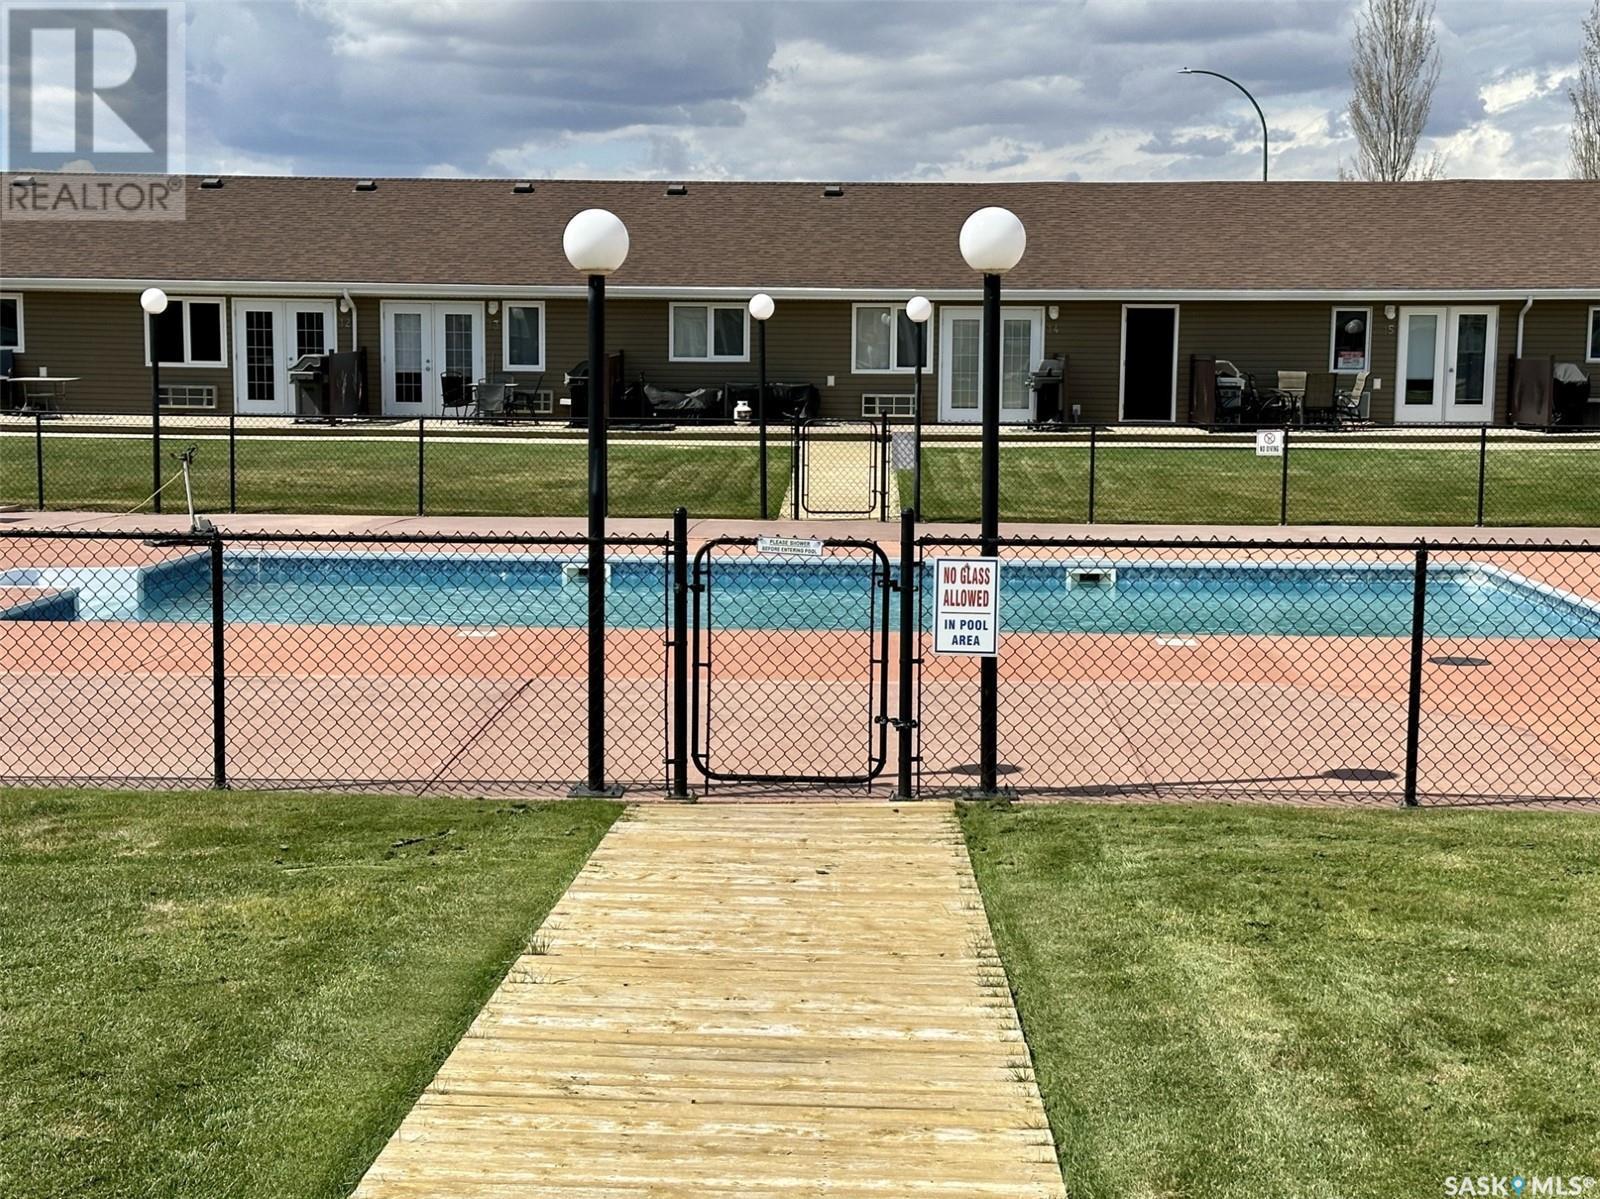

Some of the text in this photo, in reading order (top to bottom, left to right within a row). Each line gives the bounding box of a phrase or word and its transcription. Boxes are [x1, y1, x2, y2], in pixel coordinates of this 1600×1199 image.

[943, 566, 990, 585] NO GLASS
[943, 589, 989, 607] ALLOWED
[944, 619, 988, 631] IN POOL
[951, 635, 980, 646] AREA
